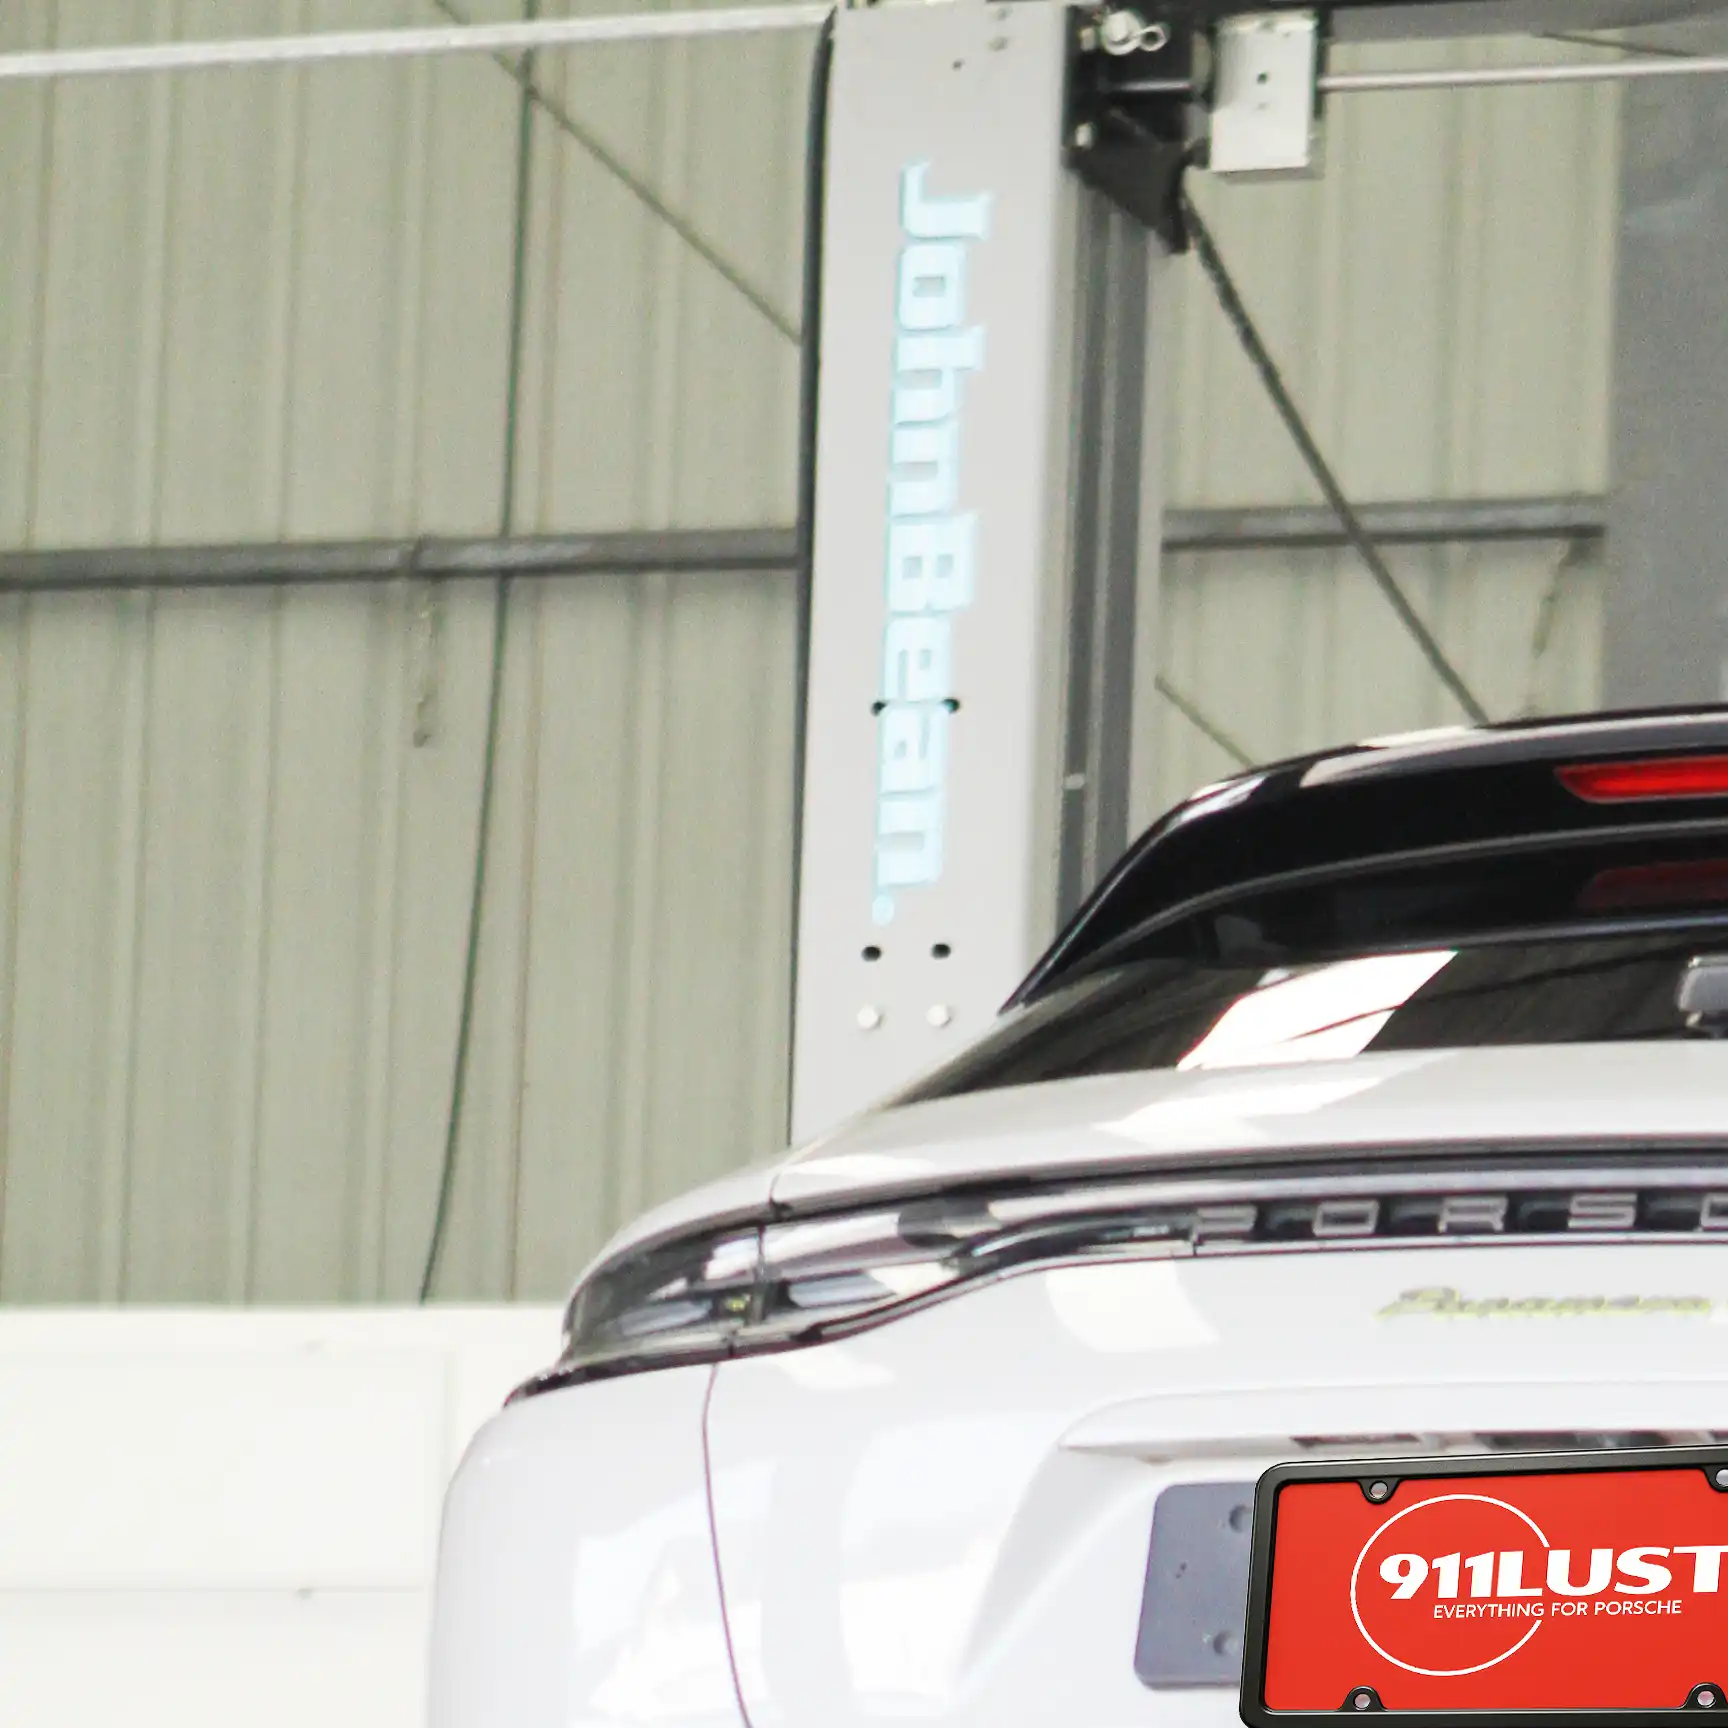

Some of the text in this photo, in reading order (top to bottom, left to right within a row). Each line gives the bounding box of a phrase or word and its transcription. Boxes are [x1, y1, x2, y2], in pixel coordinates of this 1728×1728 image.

[875, 159, 993, 888] JohnBean
[1432, 1599, 1683, 1619] EVERYTHING FOR PORSCHE
